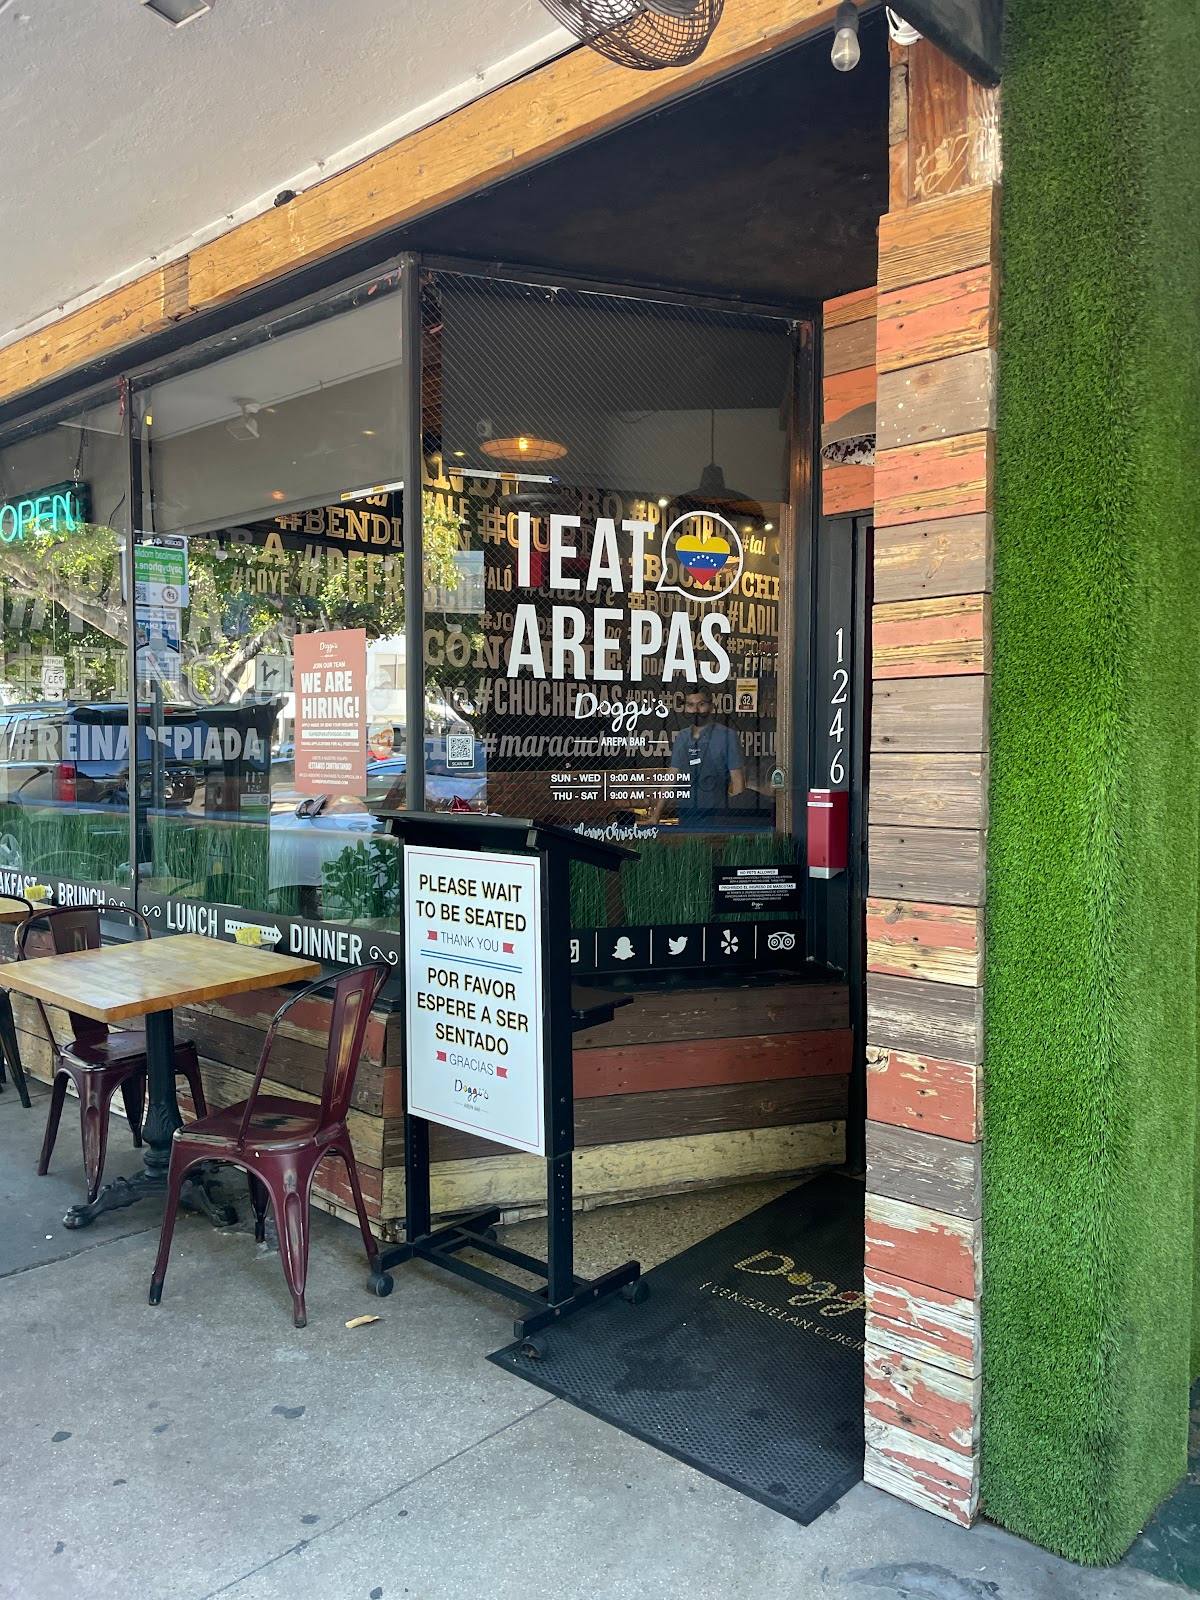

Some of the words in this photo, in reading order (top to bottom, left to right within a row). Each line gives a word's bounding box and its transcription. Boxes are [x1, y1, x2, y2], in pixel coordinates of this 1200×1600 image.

[0, 490, 77, 543] OPEN
[518, 511, 531, 588] I
[549, 514, 656, 594] EAT
[507, 603, 732, 684] AREPAS
[322, 661, 333, 669] OUR
[300, 672, 322, 693] WE
[324, 671, 353, 693] ARE
[301, 696, 360, 719] HIRING!
[574, 692, 669, 732] Doggi's
[601, 737, 628, 747] AREPA
[629, 737, 646, 747] BAR
[551, 773, 571, 783] SUN
[579, 773, 601, 783] WED
[609, 773, 628, 782] 9:00
[630, 773, 645, 782] AM
[652, 773, 675, 782] 10:00
[676, 773, 691, 782] PM
[552, 791, 573, 801] THU
[580, 791, 599, 800] SAT
[609, 790, 628, 800] 9:00
[630, 790, 645, 800] AM
[652, 790, 675, 799] 11:00
[676, 790, 691, 799] PM
[58, 882, 106, 914] BRUNCH
[418, 873, 477, 898] PLEASE
[481, 880, 523, 903] WAIT
[166, 900, 218, 938] LUNCH
[415, 899, 437, 919] TO
[440, 902, 461, 923] BE
[465, 906, 527, 932] SEATED
[289, 923, 364, 966] DINNER
[440, 931, 474, 949] THANK
[477, 936, 500, 953] YOU
[428, 967, 459, 988] POR
[464, 975, 517, 1001] FAVOR
[417, 991, 478, 1020] ESPERE
[480, 1004, 492, 1024] A
[495, 1008, 529, 1033] SER
[435, 1022, 509, 1057] SENTADO
[448, 1052, 495, 1076] GRACIAS
